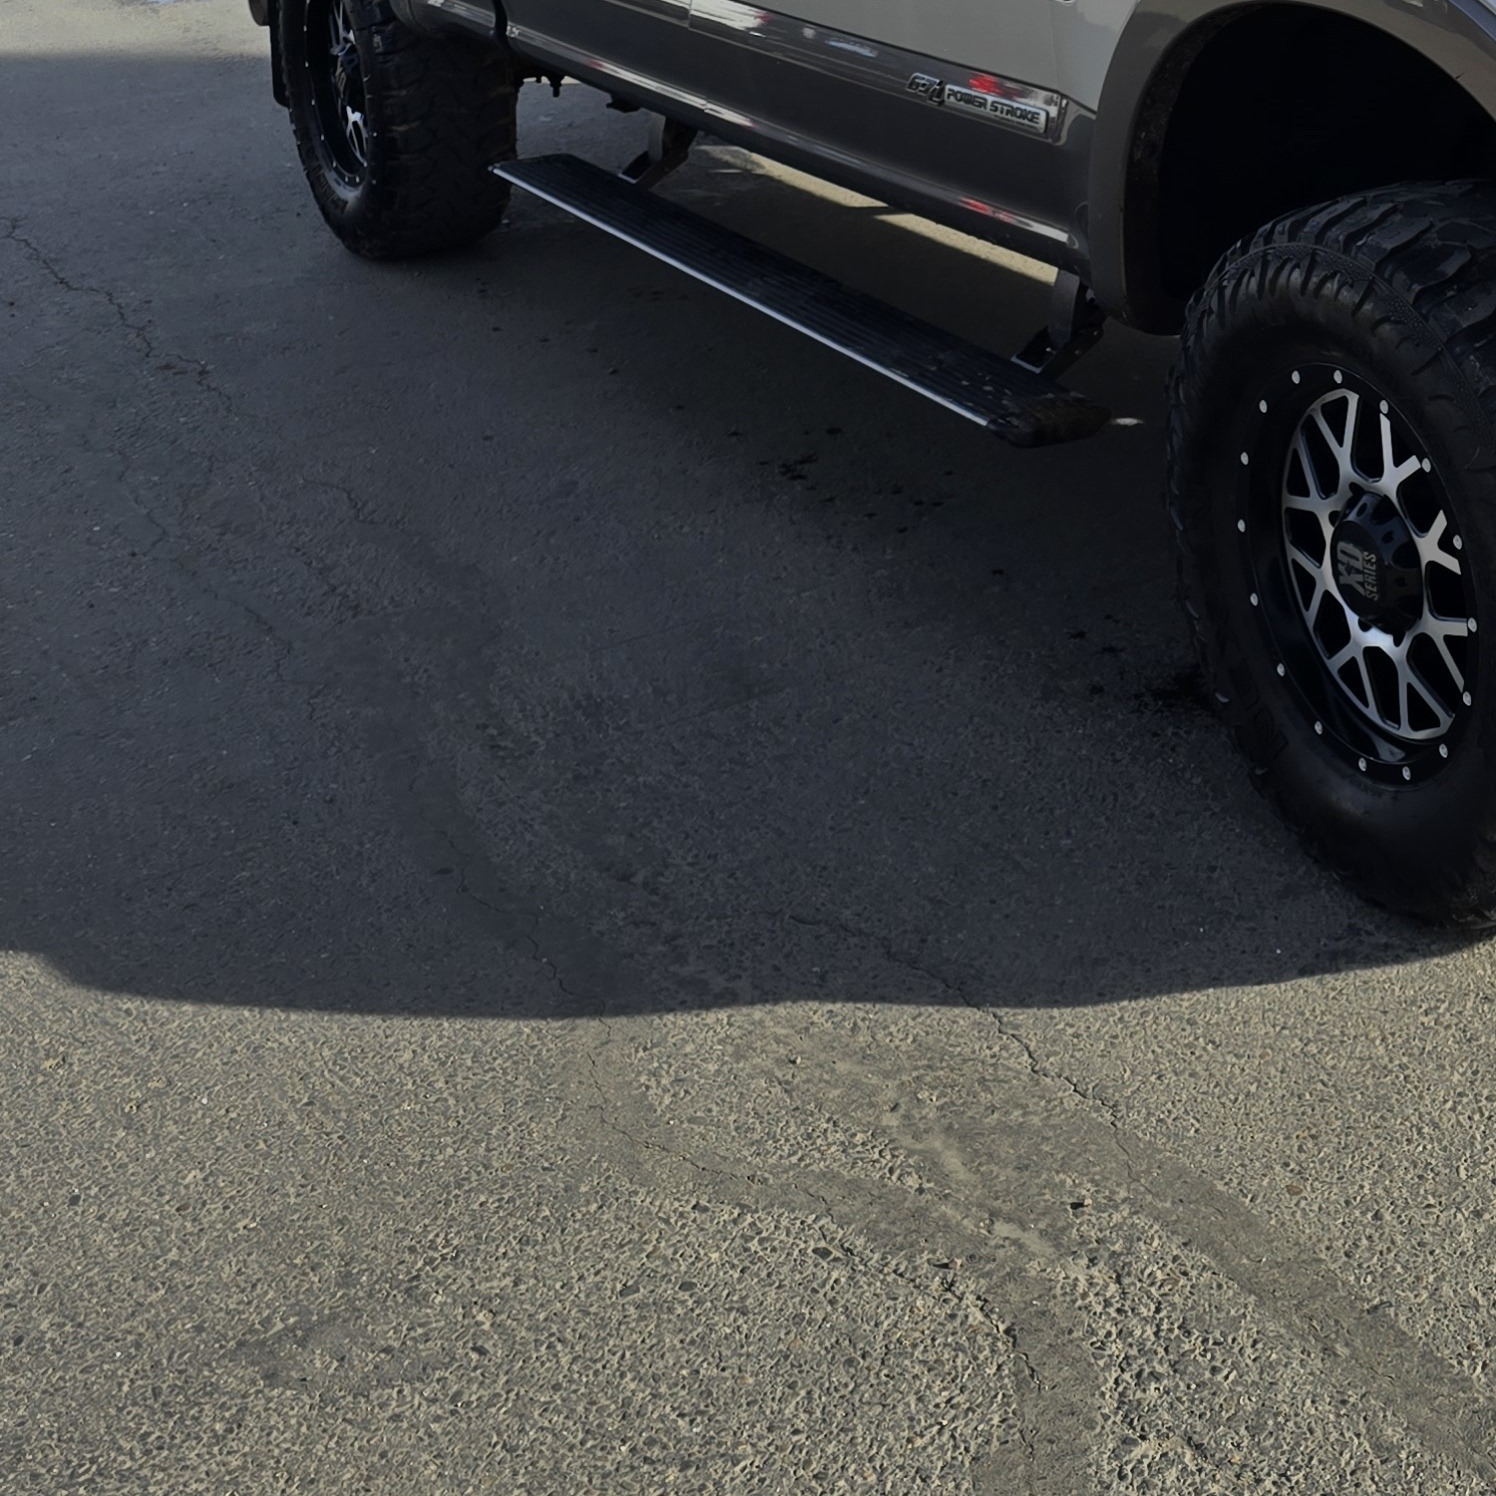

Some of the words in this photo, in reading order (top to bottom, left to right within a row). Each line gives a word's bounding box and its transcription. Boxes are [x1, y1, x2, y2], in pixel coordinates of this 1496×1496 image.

[947, 89, 988, 111] POWER
[989, 101, 1041, 125] STROKE
[1337, 541, 1365, 596] XD
[1364, 552, 1379, 601] SERIES
